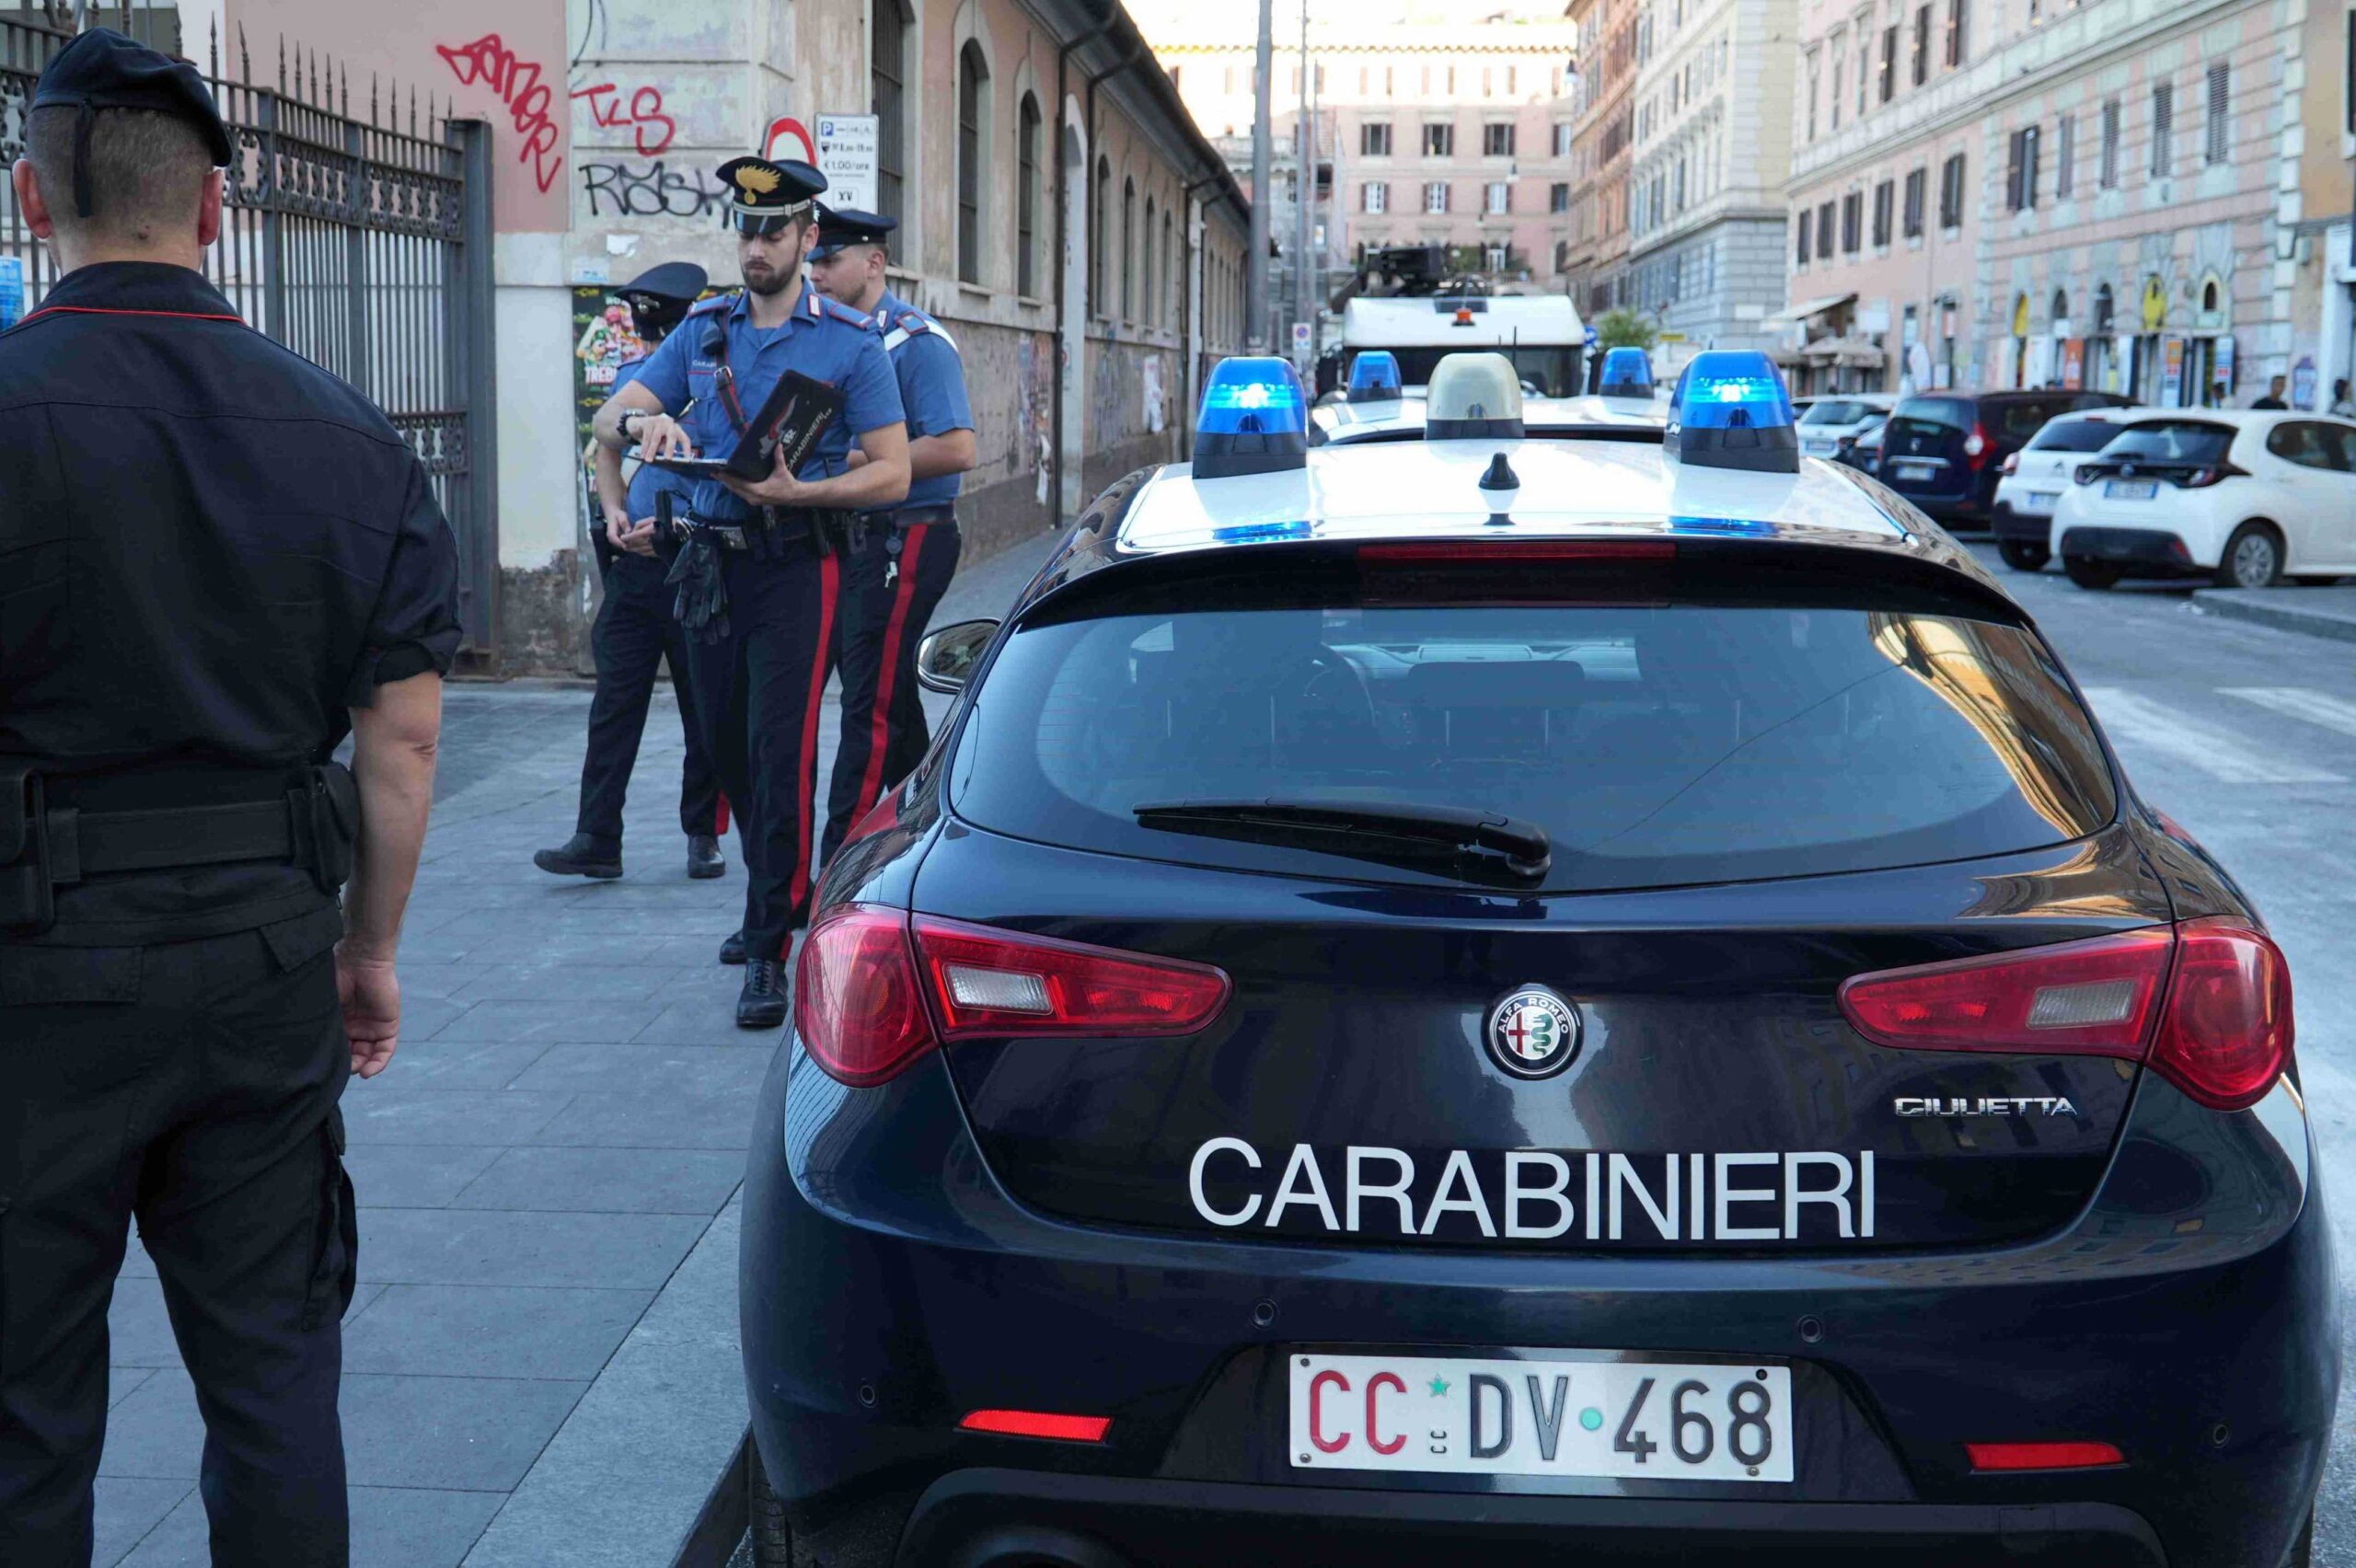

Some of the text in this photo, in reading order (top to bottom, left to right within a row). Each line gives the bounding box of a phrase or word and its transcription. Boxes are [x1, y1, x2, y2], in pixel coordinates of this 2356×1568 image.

[1498, 997, 1569, 1034] ALFA ROMEO
[1894, 1097, 2078, 1117] GIULIETTA
[1189, 1136, 1876, 1240] CARABINIERI
[1309, 1370, 1773, 1466] CC DV 468
